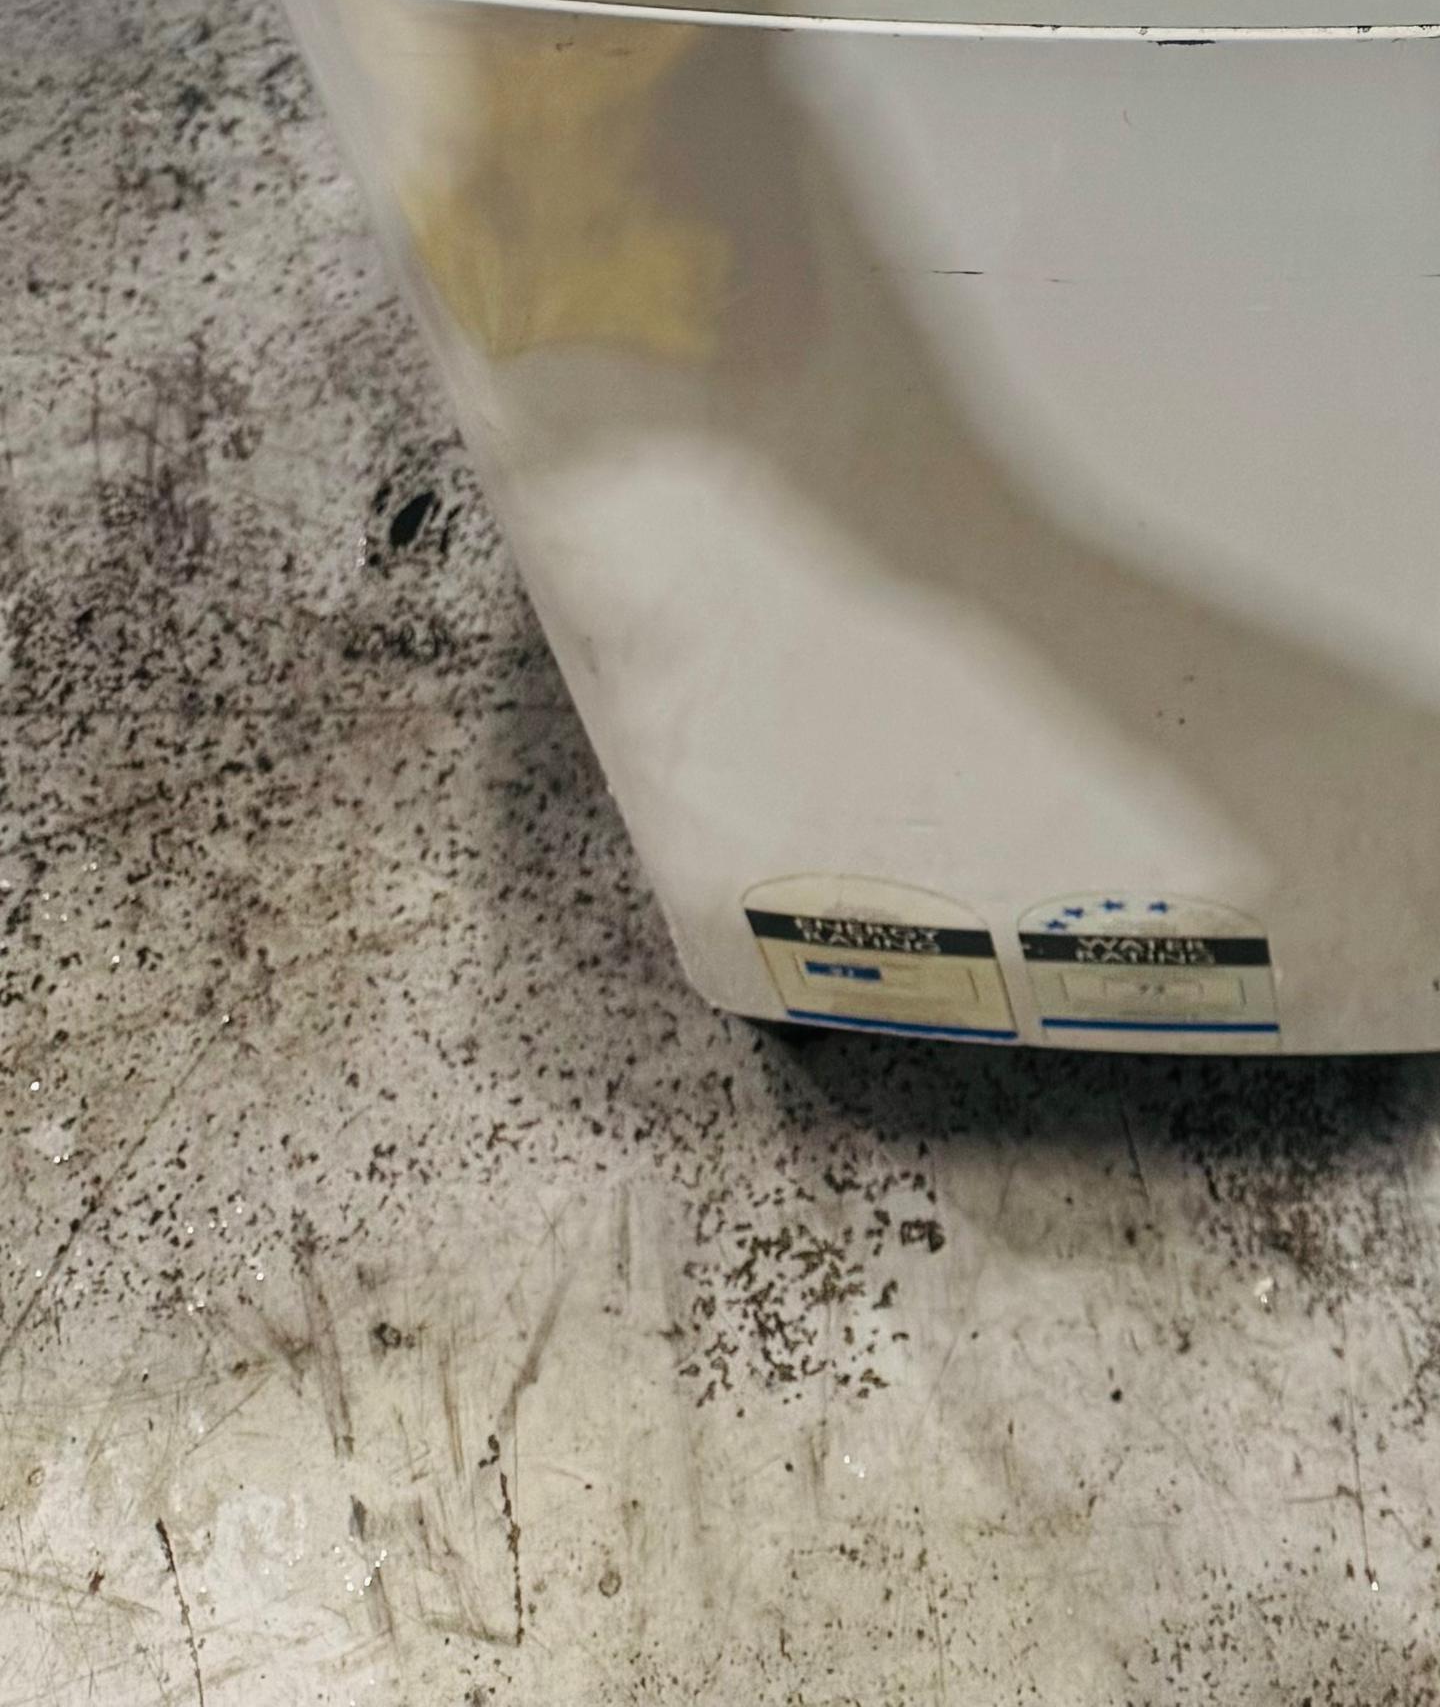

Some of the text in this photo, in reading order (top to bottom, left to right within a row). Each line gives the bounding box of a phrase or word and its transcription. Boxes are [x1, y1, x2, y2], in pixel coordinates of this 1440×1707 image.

[794, 917, 941, 941] ENERGY
[803, 929, 942, 955] RATING
[1077, 937, 1205, 952] WATER
[1074, 949, 1217, 965] RATING
